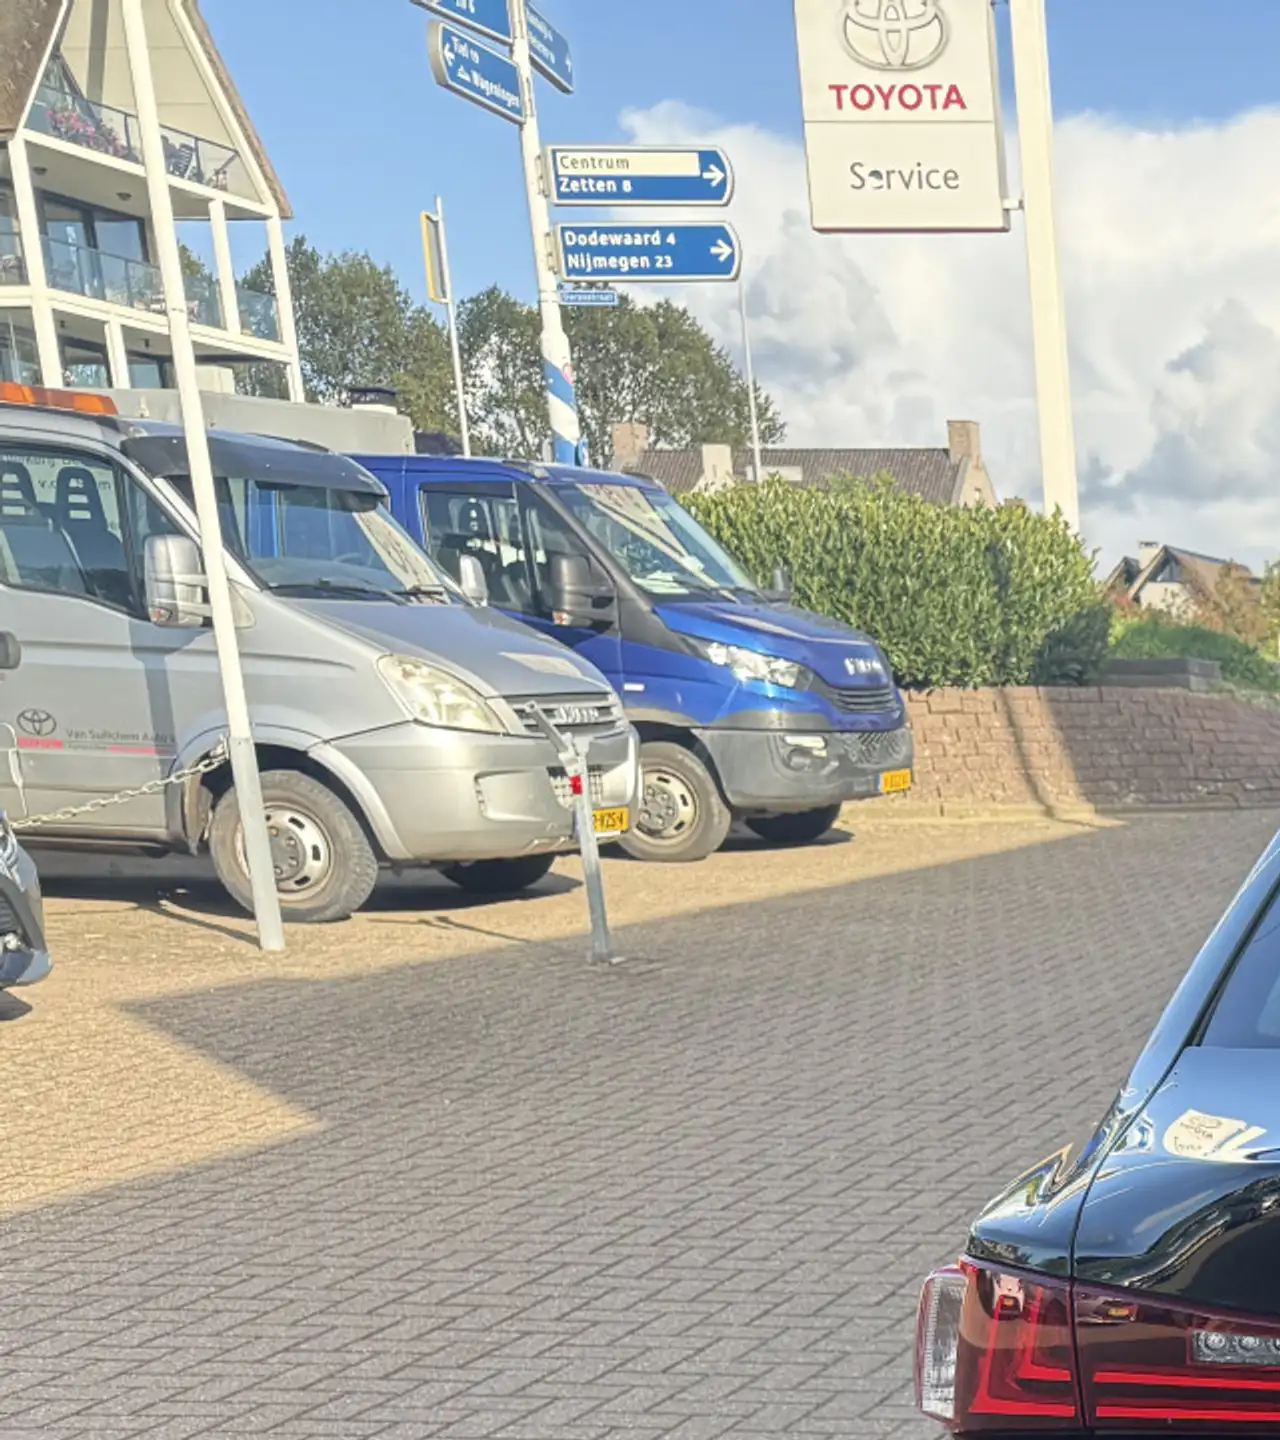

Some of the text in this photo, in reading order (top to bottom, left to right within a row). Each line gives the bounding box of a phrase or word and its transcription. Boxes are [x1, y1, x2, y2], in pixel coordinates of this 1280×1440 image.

[828, 84, 968, 111] TOYOTA
[560, 155, 630, 170] Centrum
[850, 161, 960, 190] Service
[559, 178, 632, 192] Zetten 8
[564, 230, 676, 246] Dodewaard 4
[567, 254, 673, 272] Nijmegen 23
